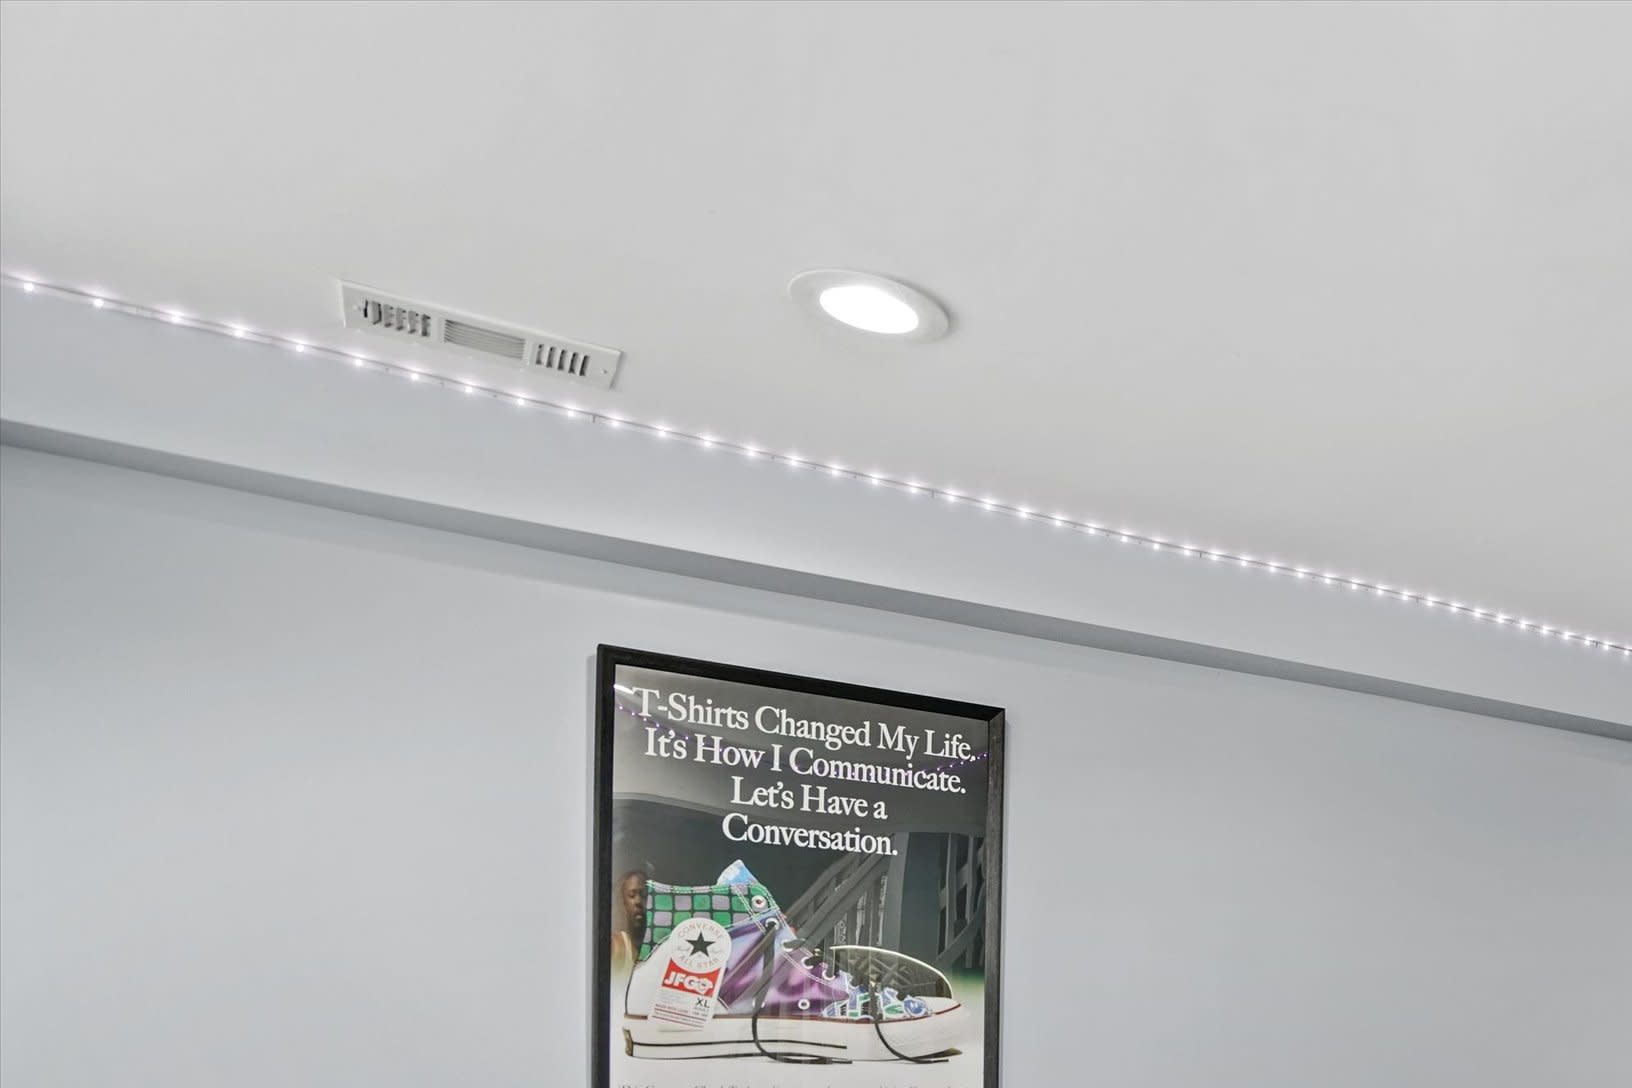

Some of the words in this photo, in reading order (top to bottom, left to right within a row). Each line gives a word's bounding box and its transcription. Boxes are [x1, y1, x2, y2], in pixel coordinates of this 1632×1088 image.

[631, 686, 749, 730] T-Shirts
[755, 706, 872, 750] Changed
[877, 722, 919, 759] My
[925, 729, 977, 762] Life.
[645, 726, 687, 760] It's
[693, 735, 765, 770] How
[771, 743, 782, 772] I
[789, 747, 967, 794] Communicate.
[731, 776, 794, 812] Let's
[800, 784, 868, 818] Have
[873, 801, 888, 820] a
[722, 813, 898, 857] Conversation.
